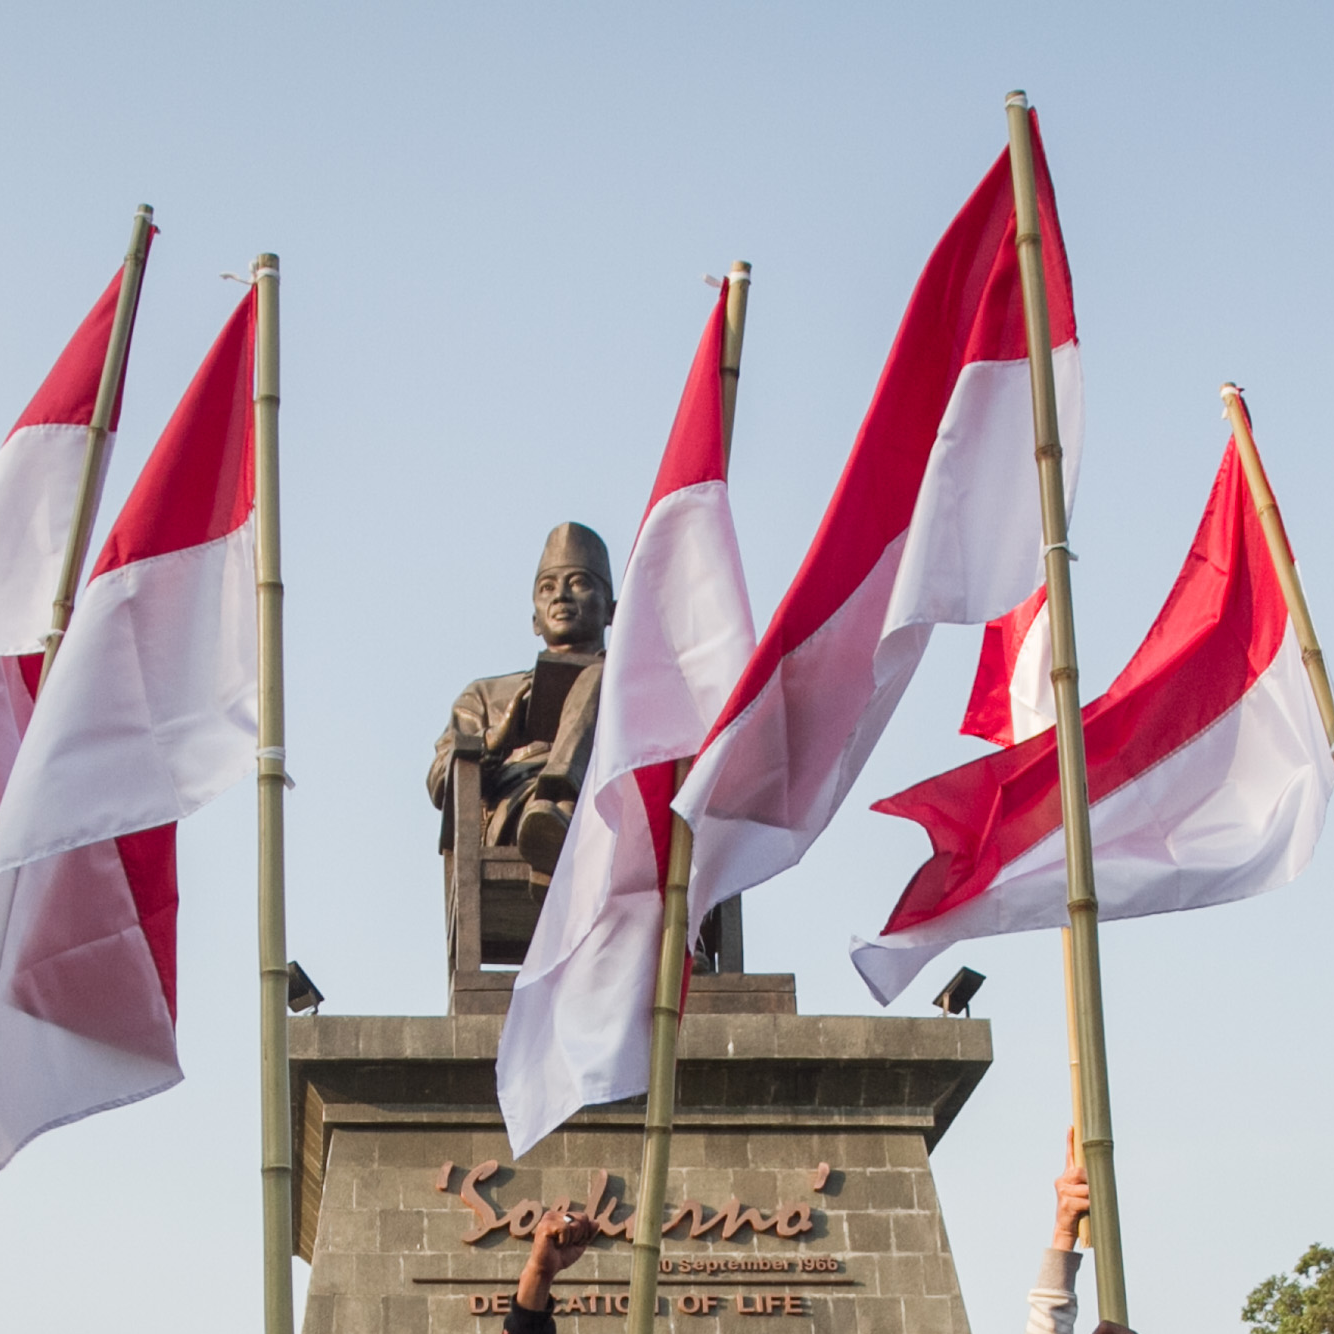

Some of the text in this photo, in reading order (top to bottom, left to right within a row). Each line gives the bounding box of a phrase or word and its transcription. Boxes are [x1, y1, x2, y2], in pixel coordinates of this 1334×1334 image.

[678, 1258, 789, 1275] September
[677, 1292, 719, 1315] OF
[735, 1292, 804, 1315] LIFE
